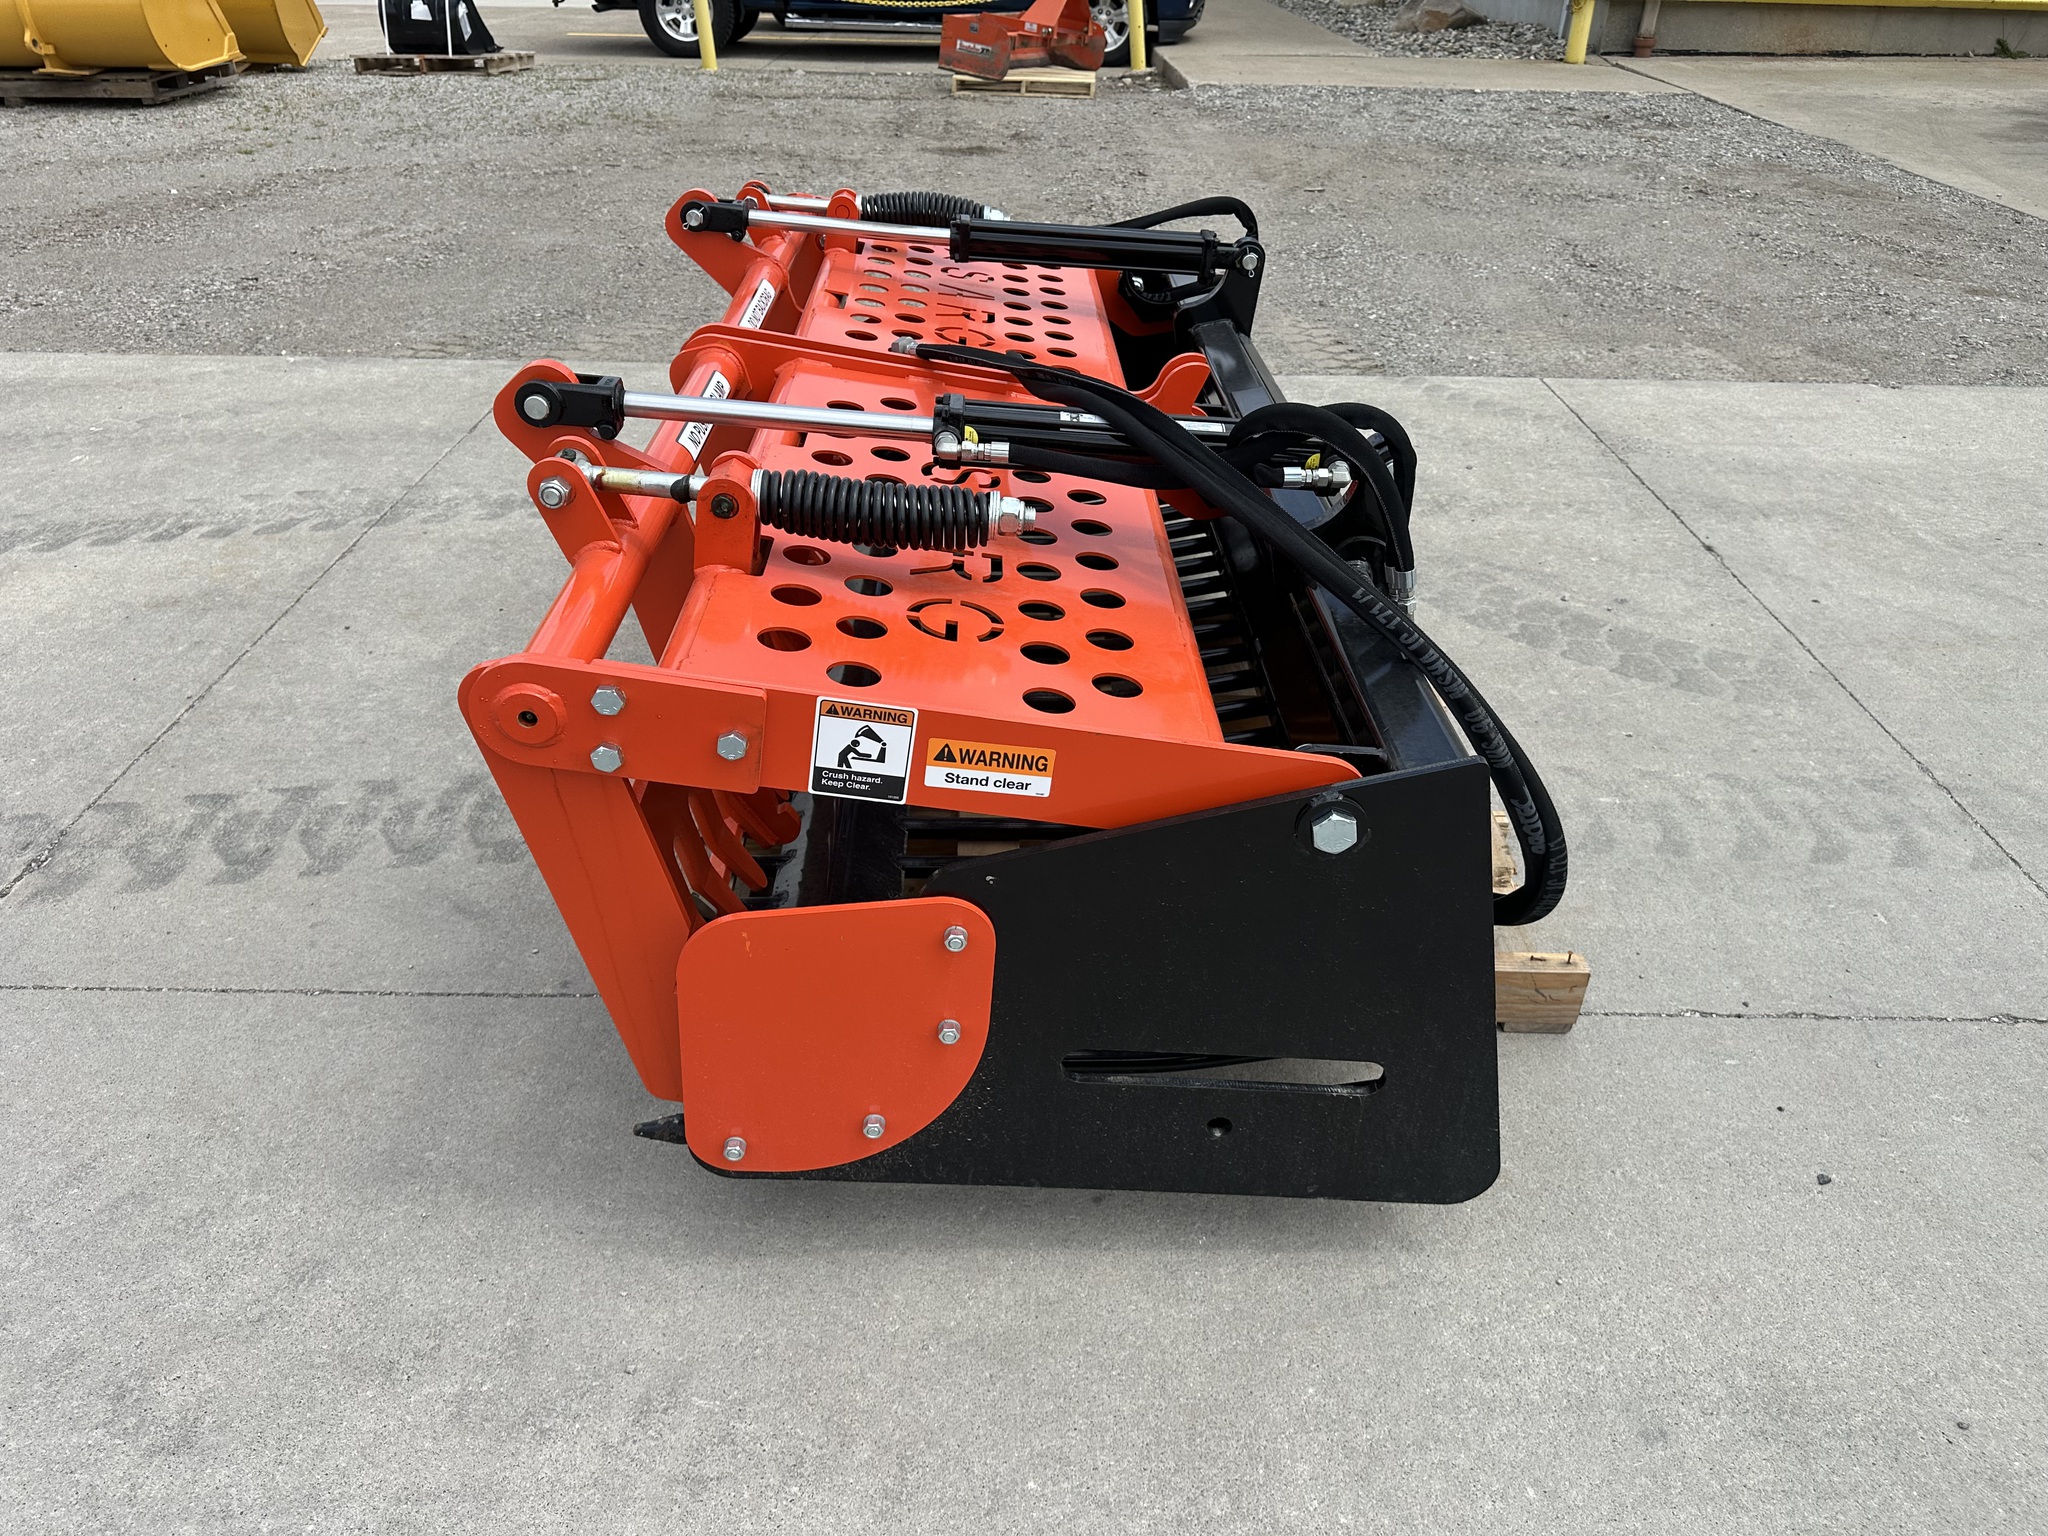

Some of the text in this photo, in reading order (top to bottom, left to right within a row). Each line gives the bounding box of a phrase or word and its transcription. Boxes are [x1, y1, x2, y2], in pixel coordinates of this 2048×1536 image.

[841, 705, 908, 724] WARNING
[958, 748, 1048, 772] WARNING
[821, 770, 883, 784] Crush hazard.
[821, 778, 871, 791] Keep Clear.
[944, 772, 1031, 791] Stand clear
